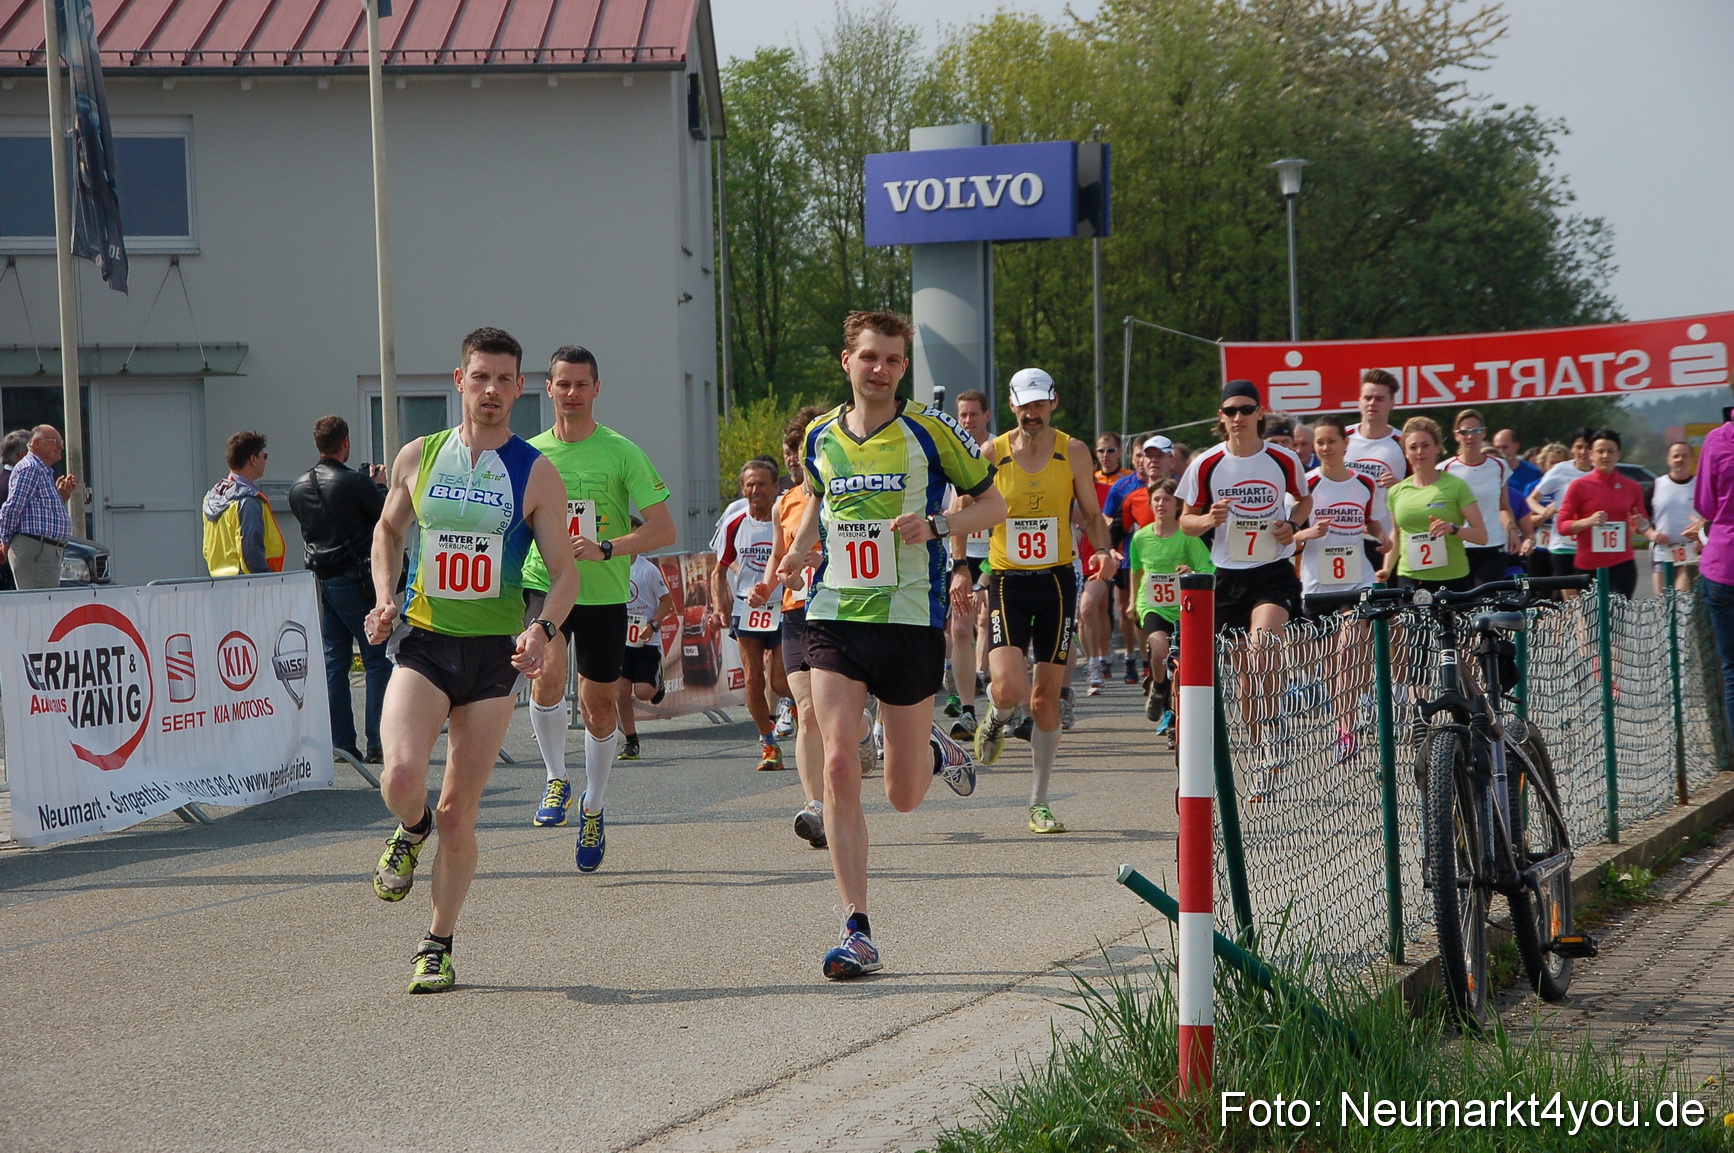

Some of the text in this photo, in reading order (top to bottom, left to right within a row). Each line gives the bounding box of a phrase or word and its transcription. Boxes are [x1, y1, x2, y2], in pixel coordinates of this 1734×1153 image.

[883, 172, 1044, 212] VOLVO
[921, 404, 981, 459] BOCK
[1343, 461, 1382, 471] GERHART
[439, 473, 482, 487] TEAM
[830, 473, 907, 496] BOCK
[429, 484, 504, 507] BOCK
[1217, 487, 1267, 497] GERHART
[1314, 508, 1360, 516] GERHART
[438, 534, 474, 544] MEYER
[837, 523, 866, 532] MEYER
[1601, 530, 1617, 548] 16
[438, 543, 474, 551] WERBUNG
[740, 547, 772, 556] GERHAR
[1018, 531, 1047, 560] 93
[1245, 531, 1258, 556] 7
[1420, 543, 1433, 566] 2
[845, 540, 880, 579] 10
[1332, 556, 1346, 580] 8
[435, 551, 492, 593] 100
[1153, 583, 1176, 603] 35
[748, 610, 772, 629] 66
[129, 653, 137, 673] &
[222, 645, 253, 678] KIA
[67, 683, 141, 729] JÄNIG
[213, 697, 275, 725] KIA MOTORS
[161, 710, 207, 733] SEAT
